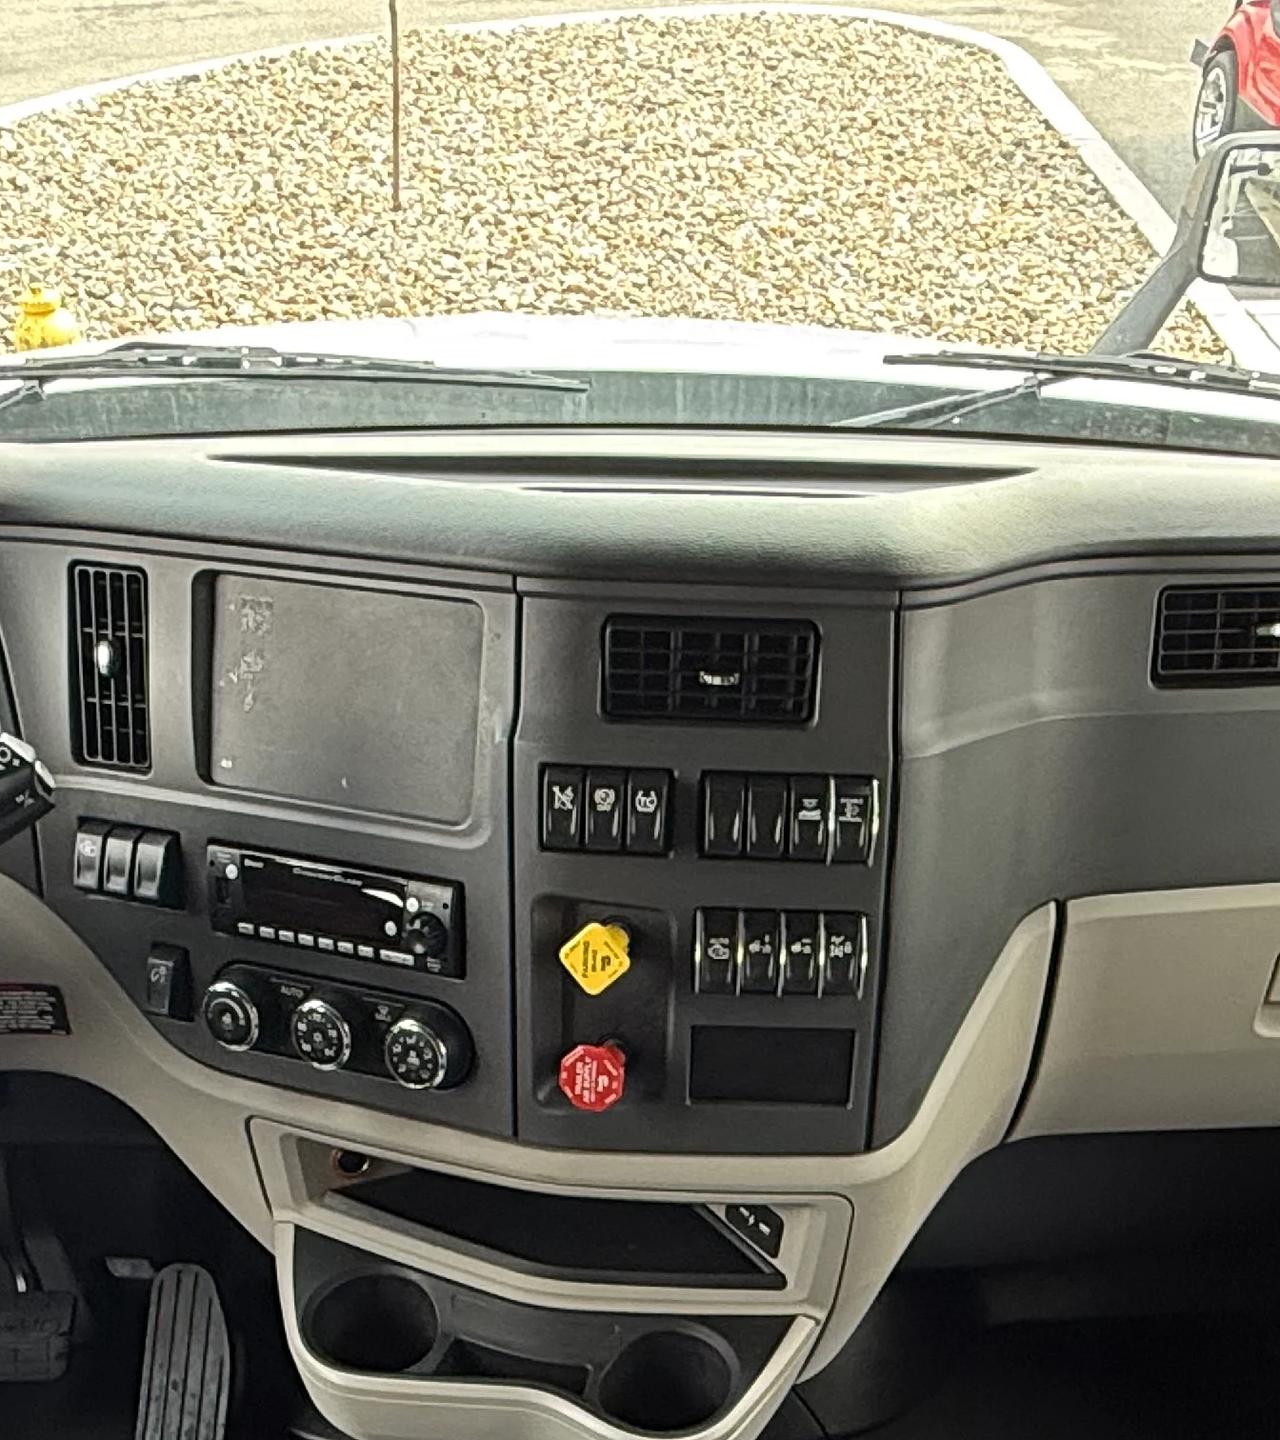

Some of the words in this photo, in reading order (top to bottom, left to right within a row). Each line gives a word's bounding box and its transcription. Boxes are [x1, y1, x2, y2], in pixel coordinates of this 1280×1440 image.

[280, 984, 304, 999] AUTO
[575, 1062, 584, 1095] TRAILER
[583, 1056, 592, 1088] SUPPLY
[583, 1089, 591, 1104] AIR
